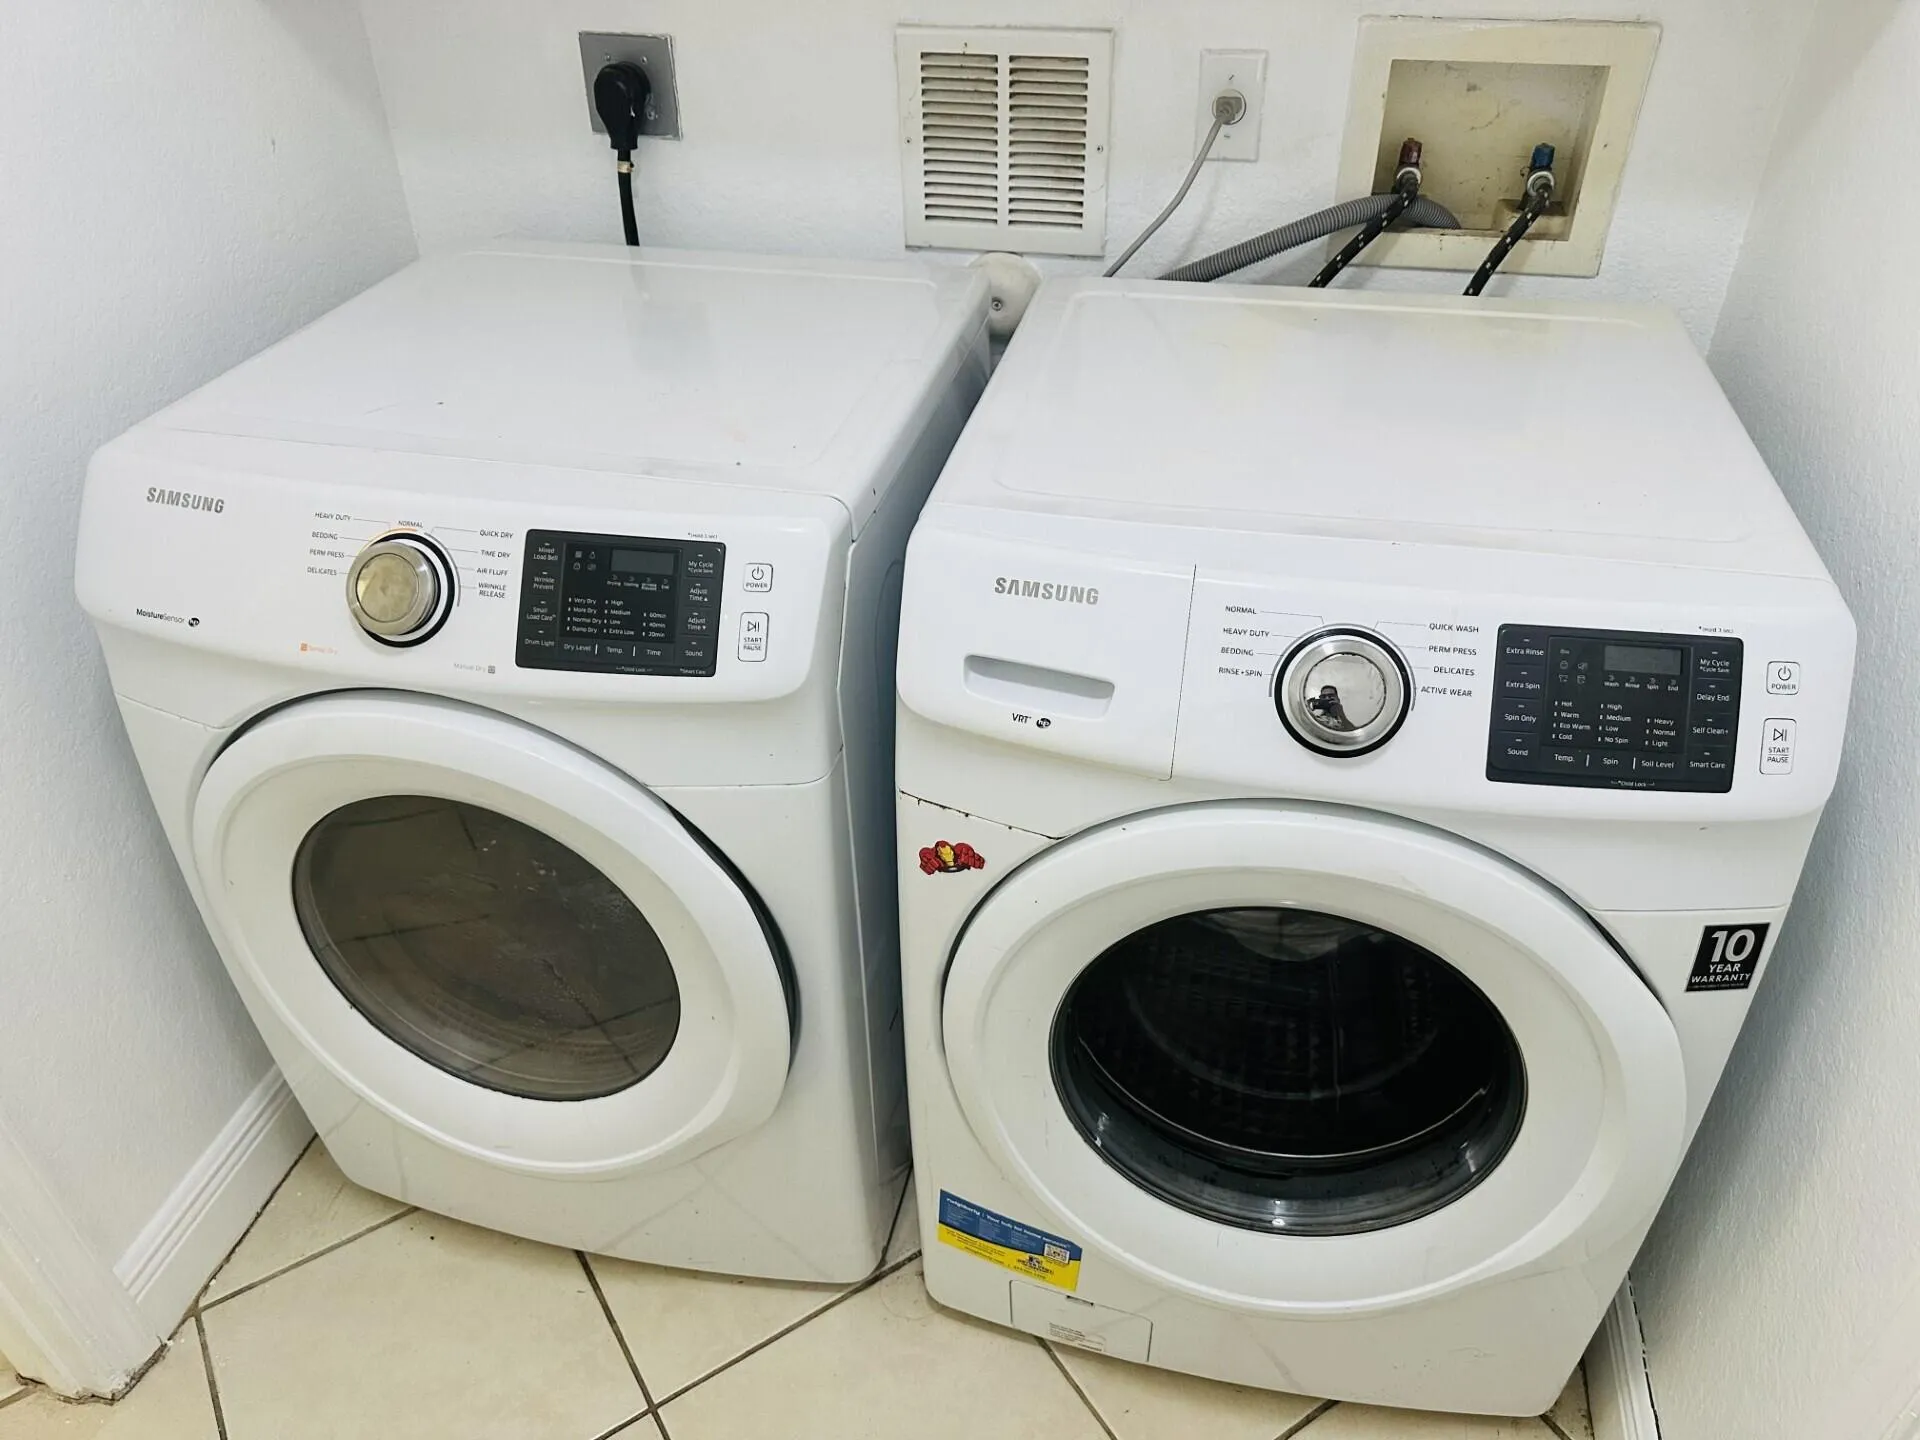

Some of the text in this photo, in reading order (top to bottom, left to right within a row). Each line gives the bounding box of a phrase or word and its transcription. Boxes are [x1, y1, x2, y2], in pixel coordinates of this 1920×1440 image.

[147, 487, 225, 514] SAMSUNG
[315, 512, 334, 520] HEAVY
[398, 520, 424, 529] NORMAL
[312, 531, 338, 540] BEDDING
[480, 529, 514, 539] QUICK DRY
[310, 548, 345, 558] PERM PRESS
[481, 550, 496, 558] TIME
[689, 560, 698, 568] My
[307, 566, 337, 576] DELICATES
[478, 582, 507, 591] WRINKLE
[533, 583, 554, 591] Prevent
[994, 577, 1099, 605] SAMSUNG
[479, 590, 505, 599] RELEASE
[690, 588, 708, 596] Adjust
[574, 597, 597, 606] Very Dry
[1225, 605, 1257, 615] NORMAL
[1223, 627, 1269, 638] HEAVY DUTY
[1429, 623, 1479, 633] QUICK WASH
[564, 643, 575, 651] Dry
[1428, 645, 1477, 656] PERM PRESS
[1506, 647, 1544, 656] Extra Rinse
[1221, 647, 1254, 657] BEDDING
[1700, 658, 1730, 668] My Cycle
[1433, 666, 1475, 676] DELICATES
[1525, 682, 1540, 690] Spin
[1420, 686, 1473, 697] ACTIVE WEAR
[1696, 693, 1715, 702] Delay
[1607, 703, 1622, 711] High
[1504, 713, 1536, 723] Spin Only
[1606, 714, 1631, 722] Medium
[1654, 718, 1674, 726] Heavy
[1616, 737, 1629, 745] Spin
[1507, 748, 1528, 756] Sound
[1554, 754, 1575, 763] Temp.
[1602, 757, 1619, 766] Spin
[1711, 929, 1755, 962] 10
[1709, 963, 1741, 973] YEAR
[1691, 973, 1751, 983] WARRANTY
